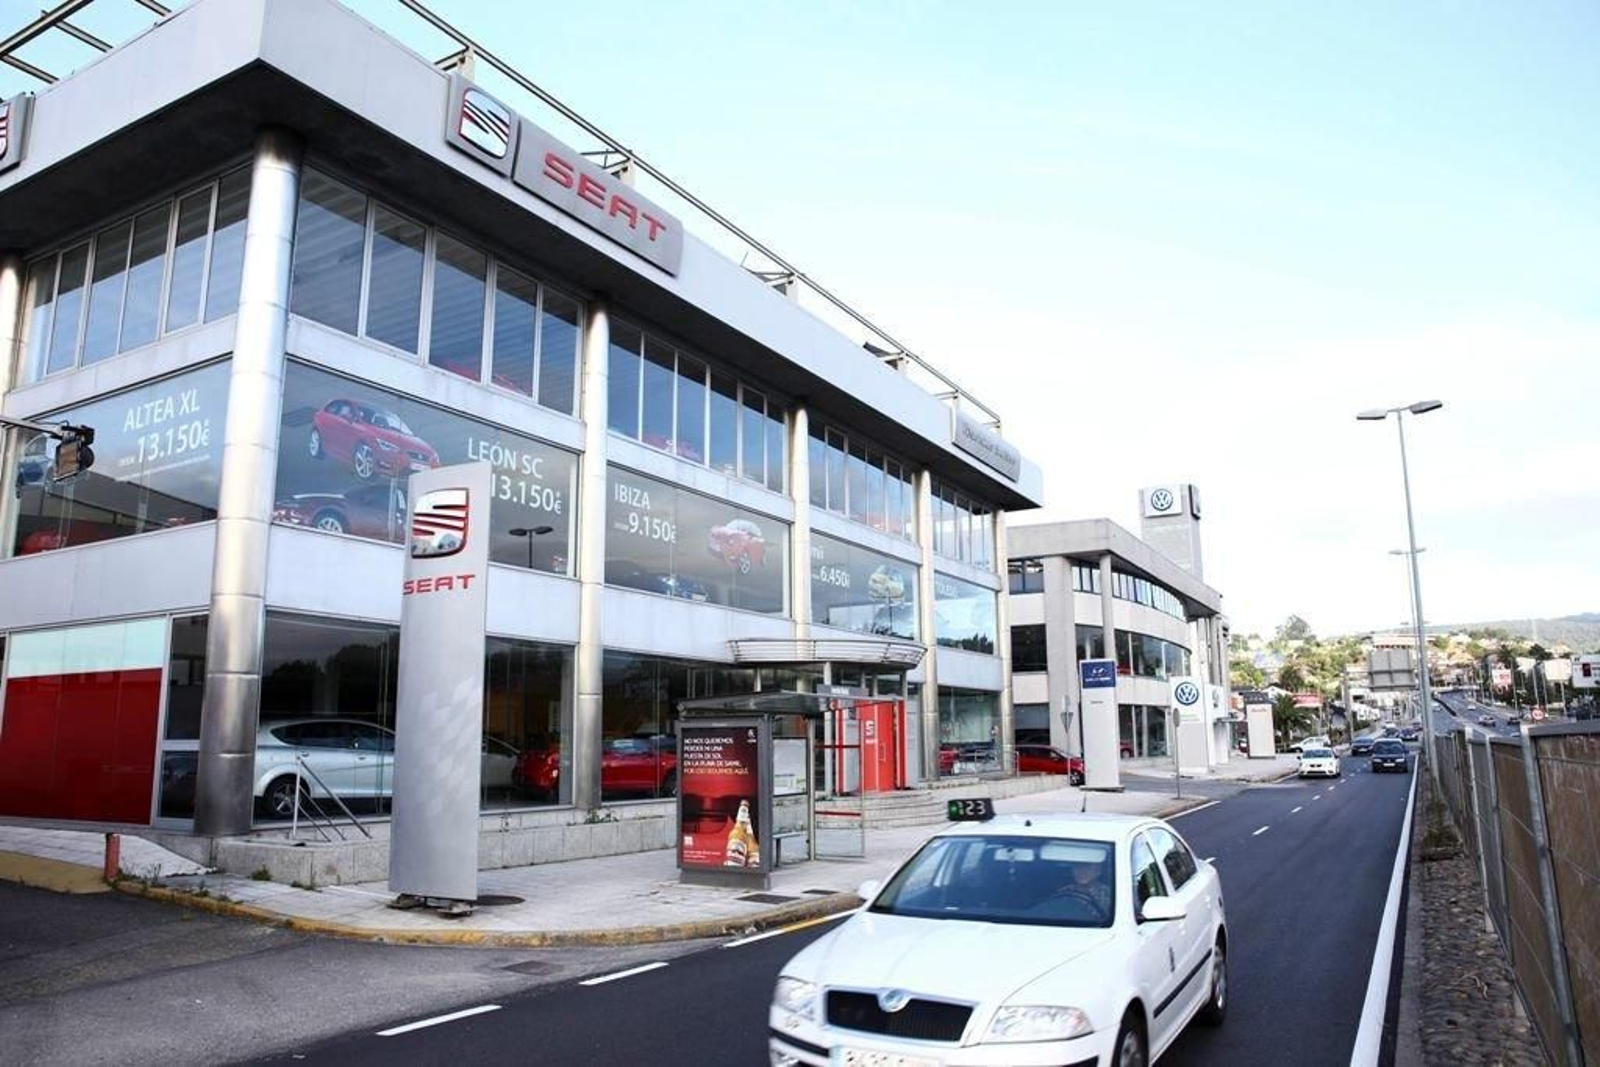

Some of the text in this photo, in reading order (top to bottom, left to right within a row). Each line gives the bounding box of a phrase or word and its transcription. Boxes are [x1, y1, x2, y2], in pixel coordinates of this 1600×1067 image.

[543, 150, 667, 241] SEAT
[123, 386, 201, 433] ALTEA XL
[521, 453, 544, 480] SC
[614, 482, 651, 510] IBIZA
[403, 574, 475, 596] SEAT
